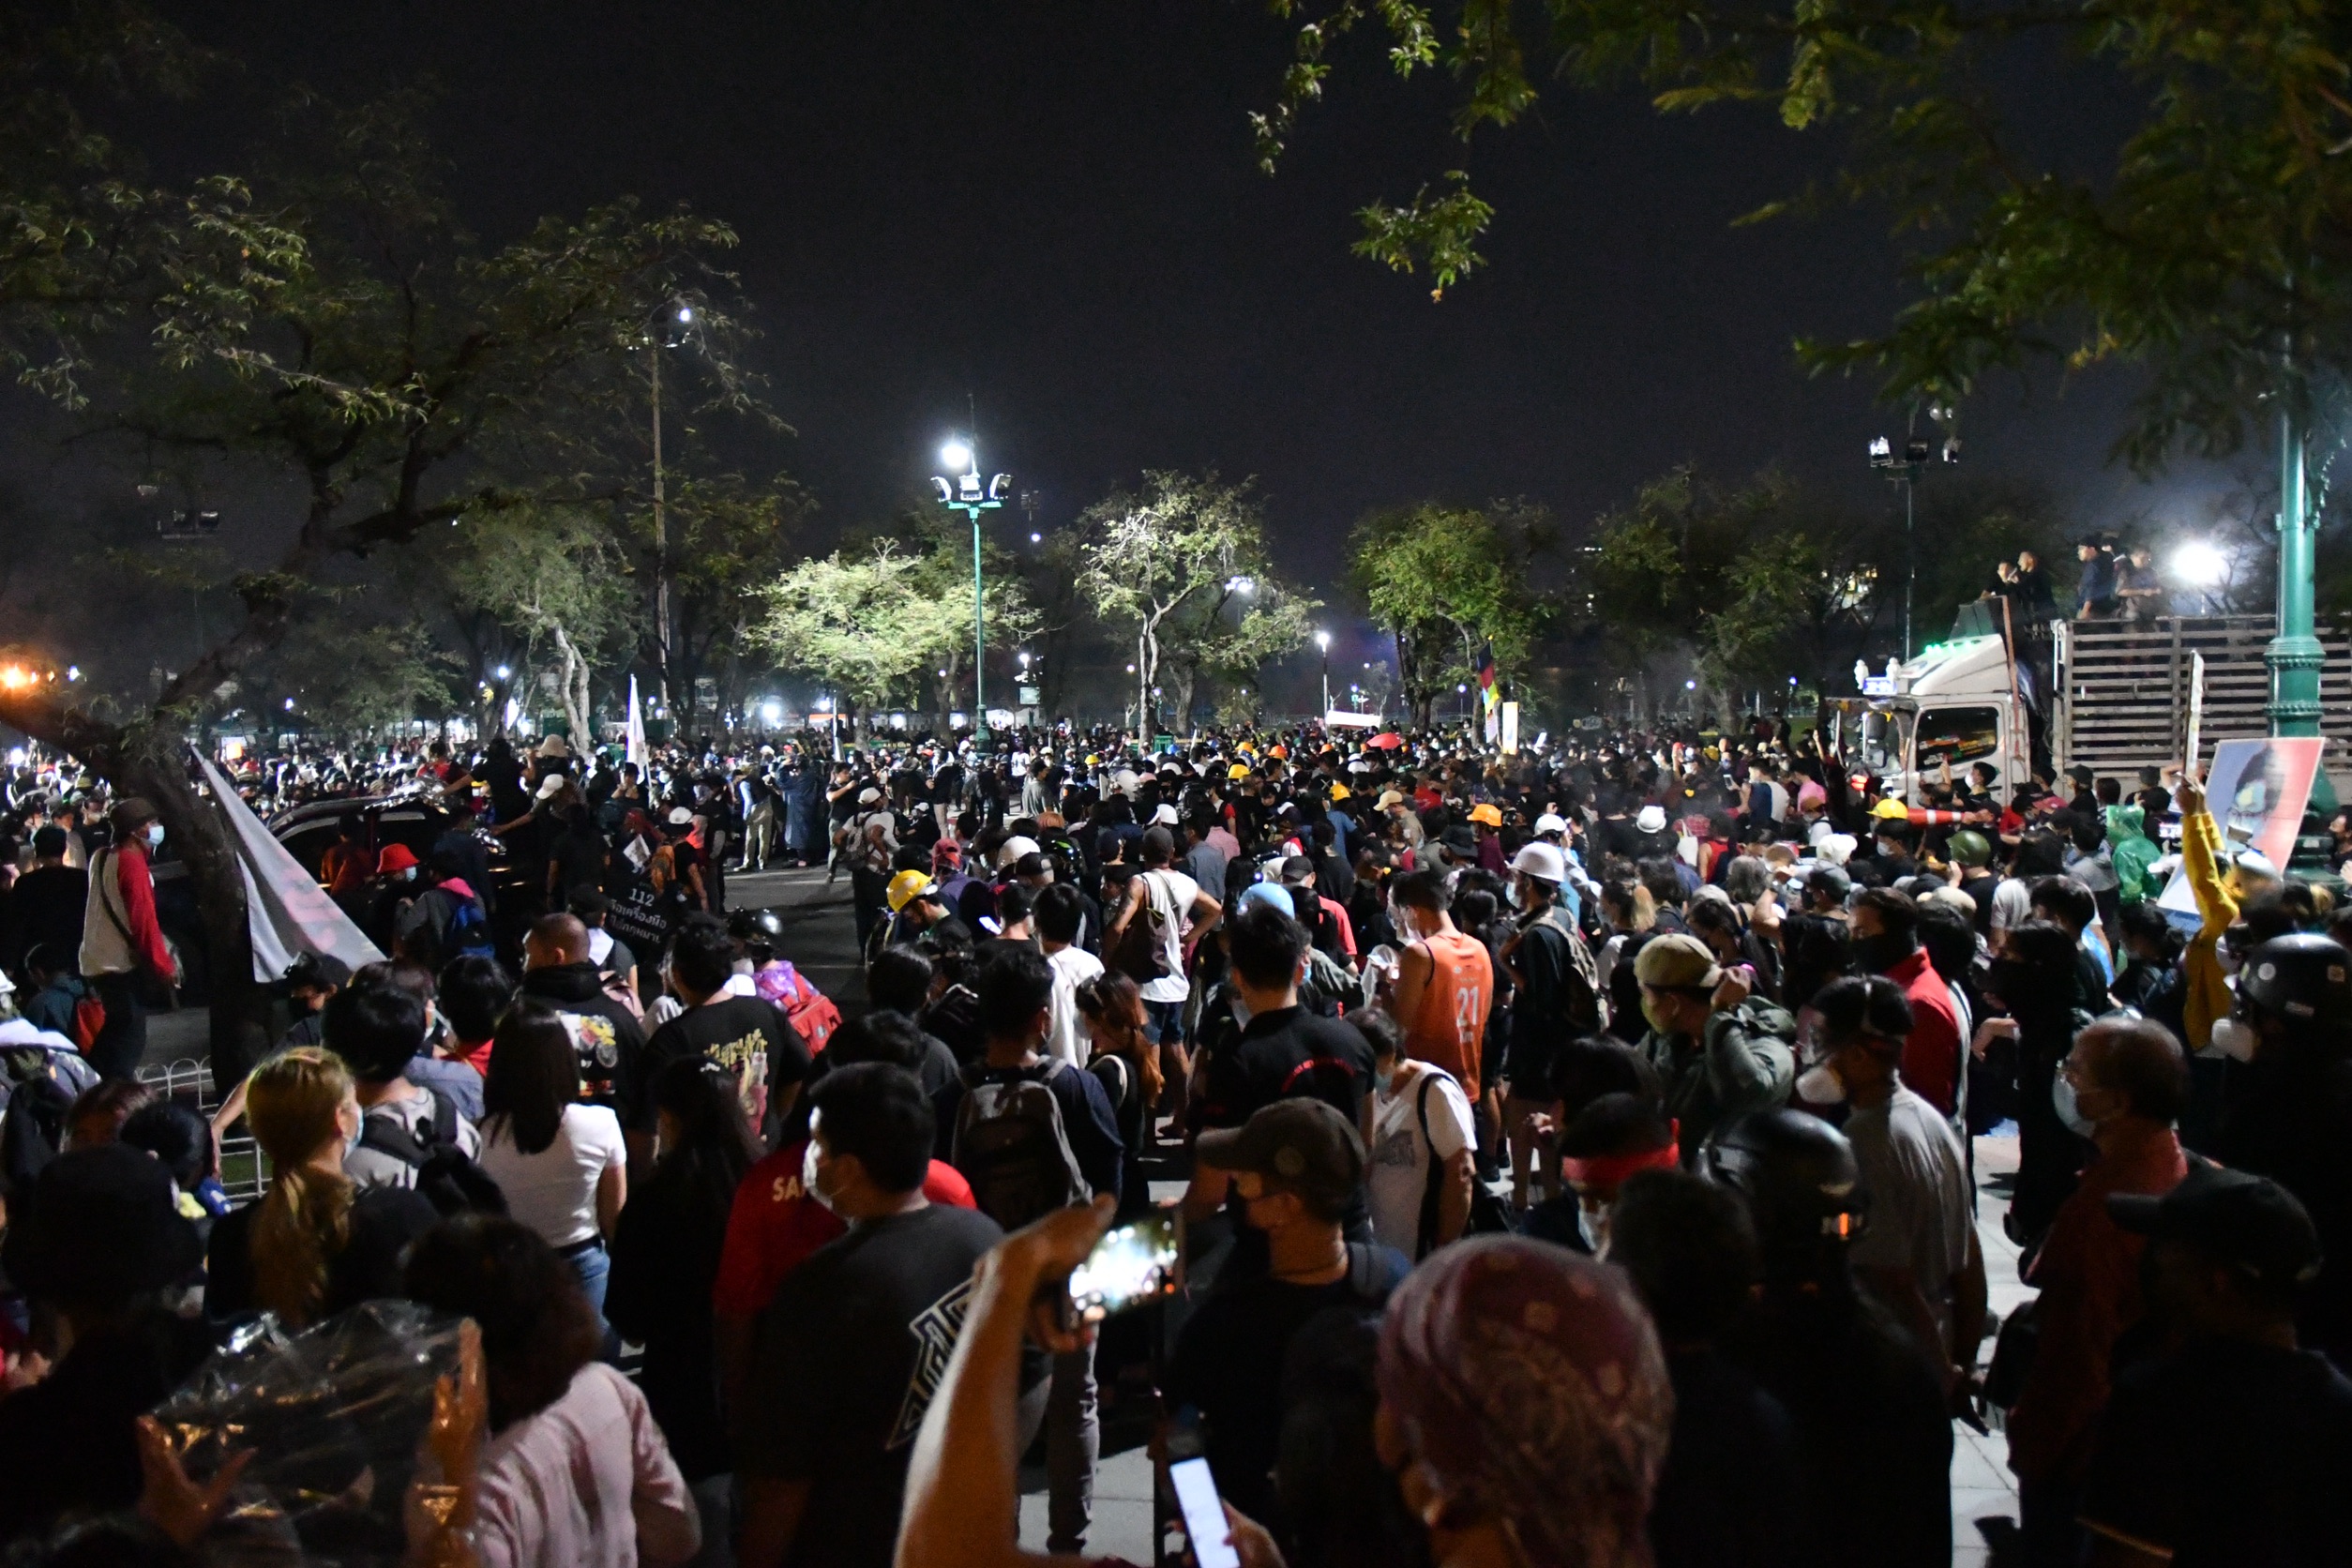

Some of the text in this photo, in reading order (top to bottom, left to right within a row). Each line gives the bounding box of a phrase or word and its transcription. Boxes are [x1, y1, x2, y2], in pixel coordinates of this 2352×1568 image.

[628, 887, 655, 907] 112
[1455, 986, 1479, 1027] 21
[772, 1175, 806, 1201] SA
